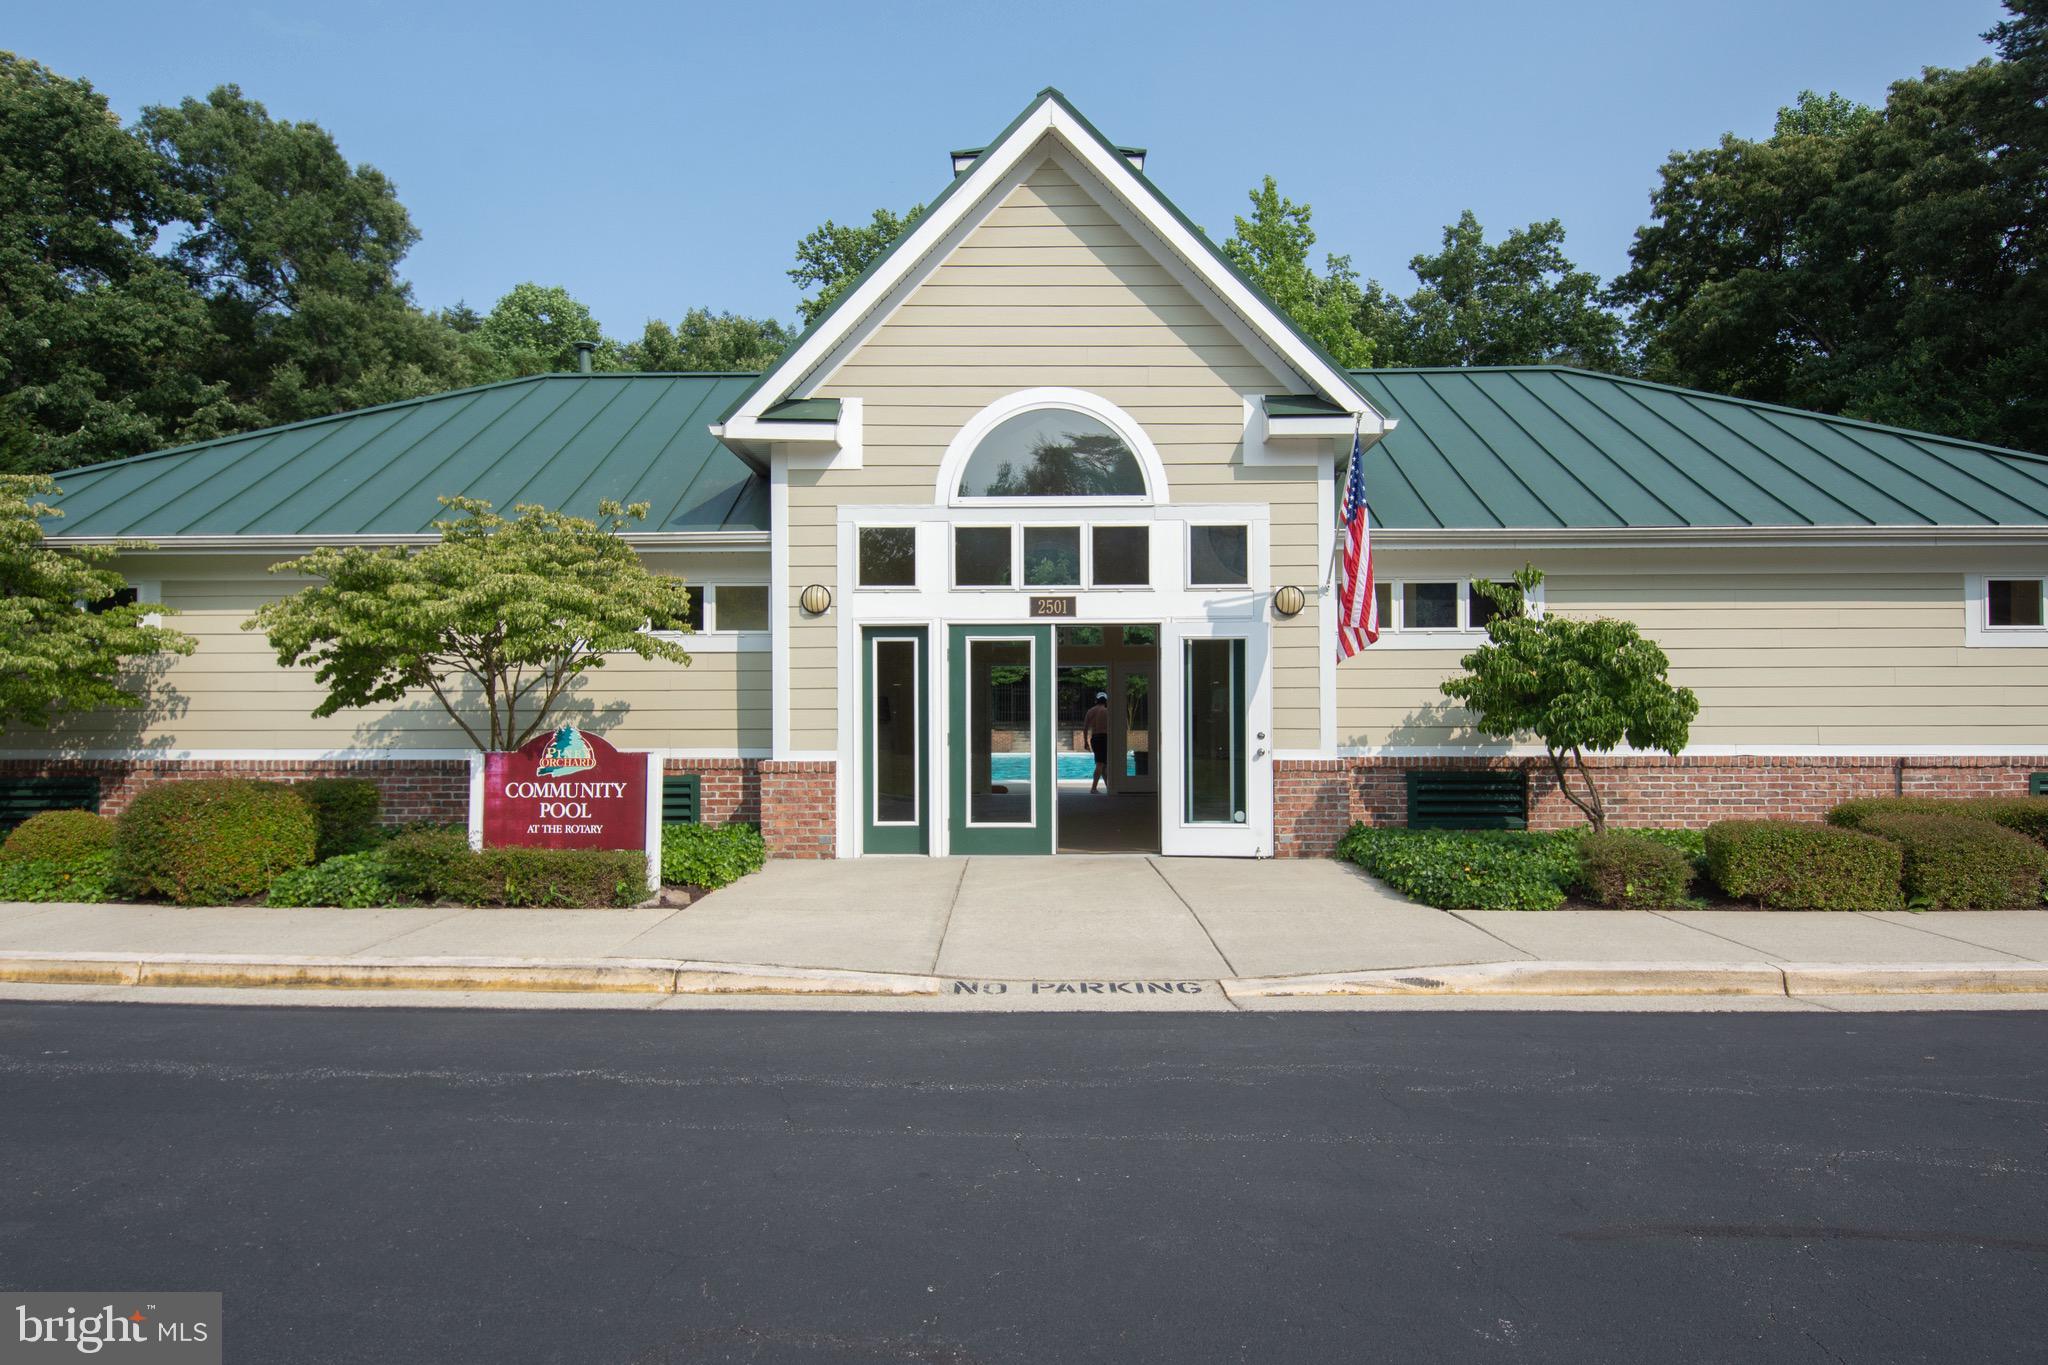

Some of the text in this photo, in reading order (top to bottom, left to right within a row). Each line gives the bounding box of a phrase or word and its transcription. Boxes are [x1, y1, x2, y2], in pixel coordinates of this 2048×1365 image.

[1038, 599, 1067, 614] 2501
[541, 758, 594, 767] ORCHARD
[505, 782, 627, 798] COMMUNITY
[539, 802, 592, 818] POOL
[527, 824, 603, 834] AT THE ROTARY
[953, 980, 1202, 995] NO PARKING
